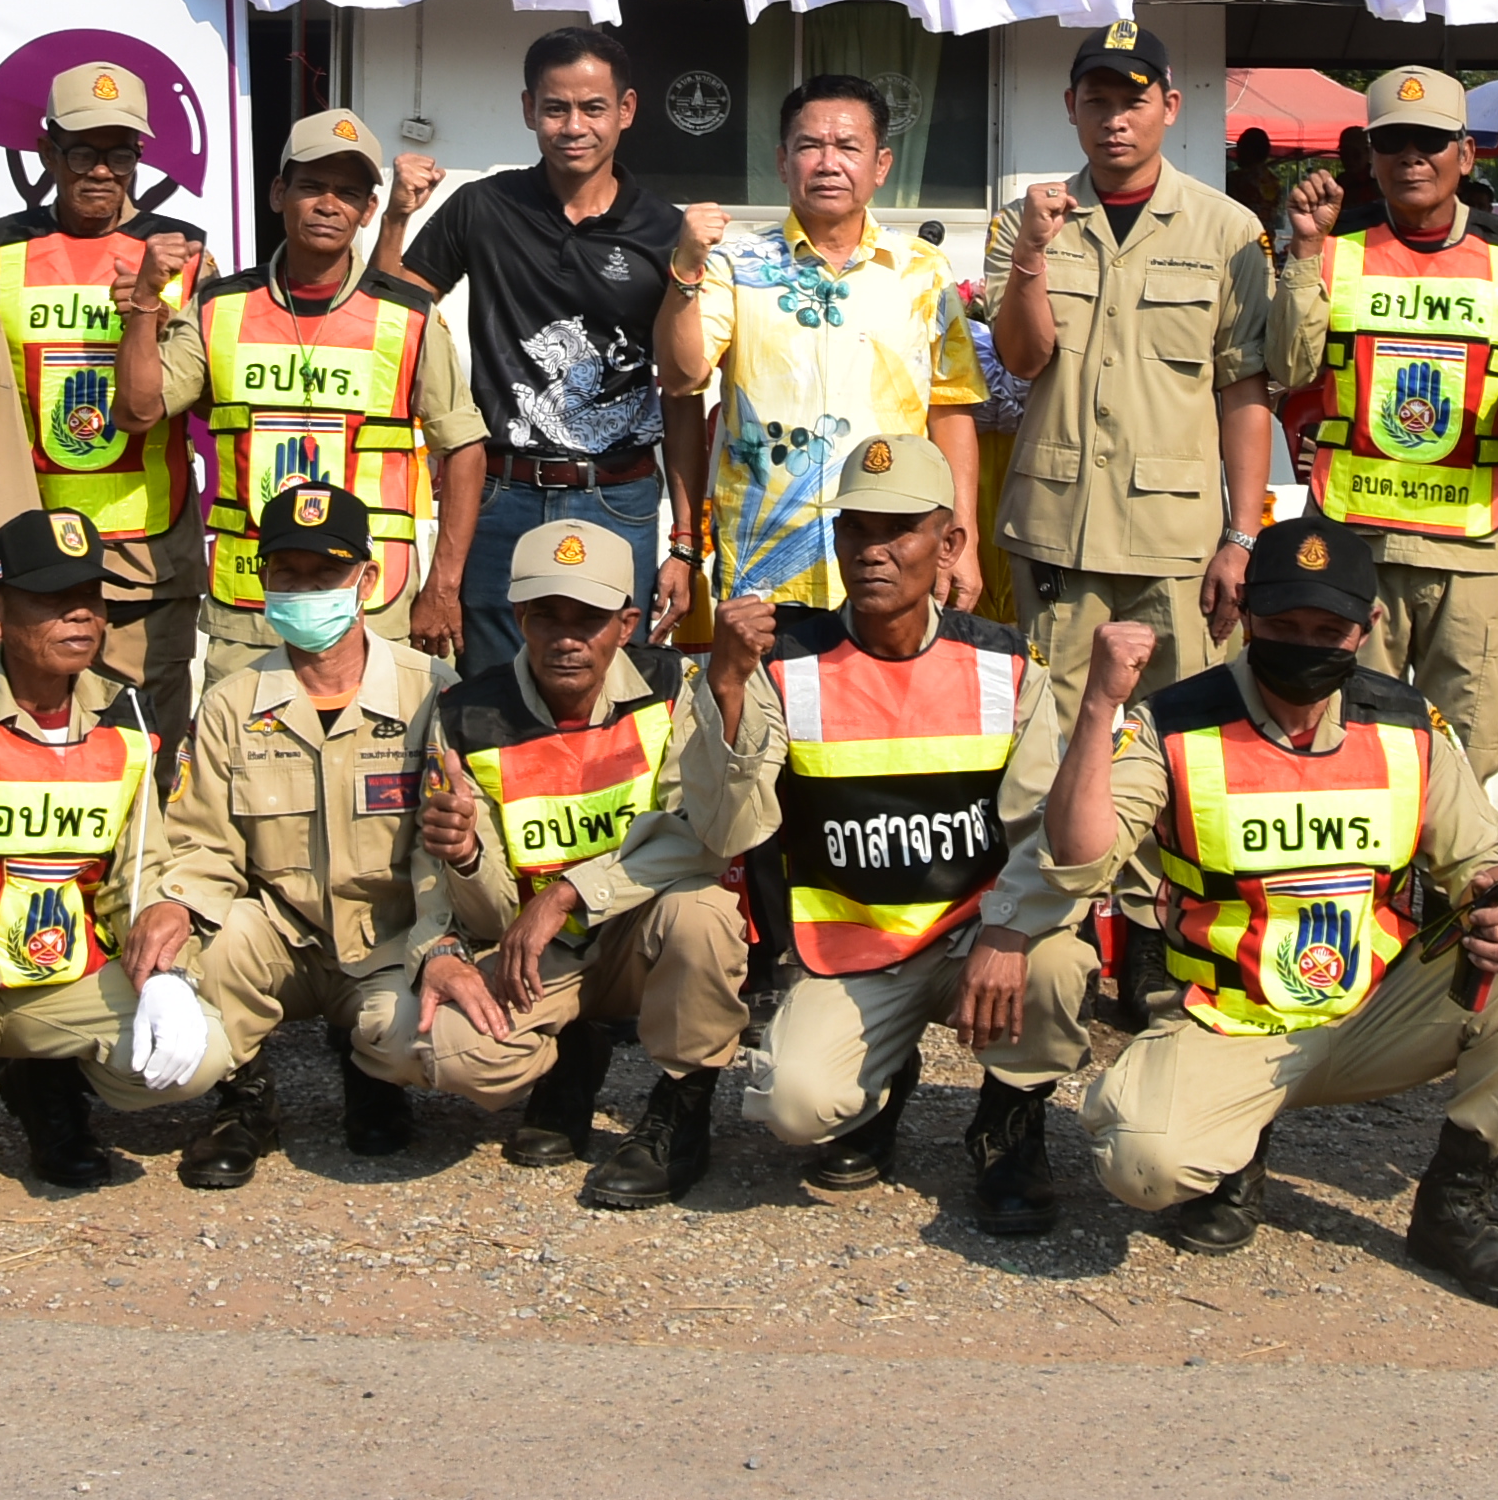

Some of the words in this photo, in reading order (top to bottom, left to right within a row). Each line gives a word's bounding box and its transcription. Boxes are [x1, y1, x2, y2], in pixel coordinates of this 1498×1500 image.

[1370, 284, 1485, 324] อปพร.
[244, 353, 360, 397] อปพร.
[1351, 473, 1470, 506] อบต.นากอก
[1241, 803, 1381, 851] อปพร.
